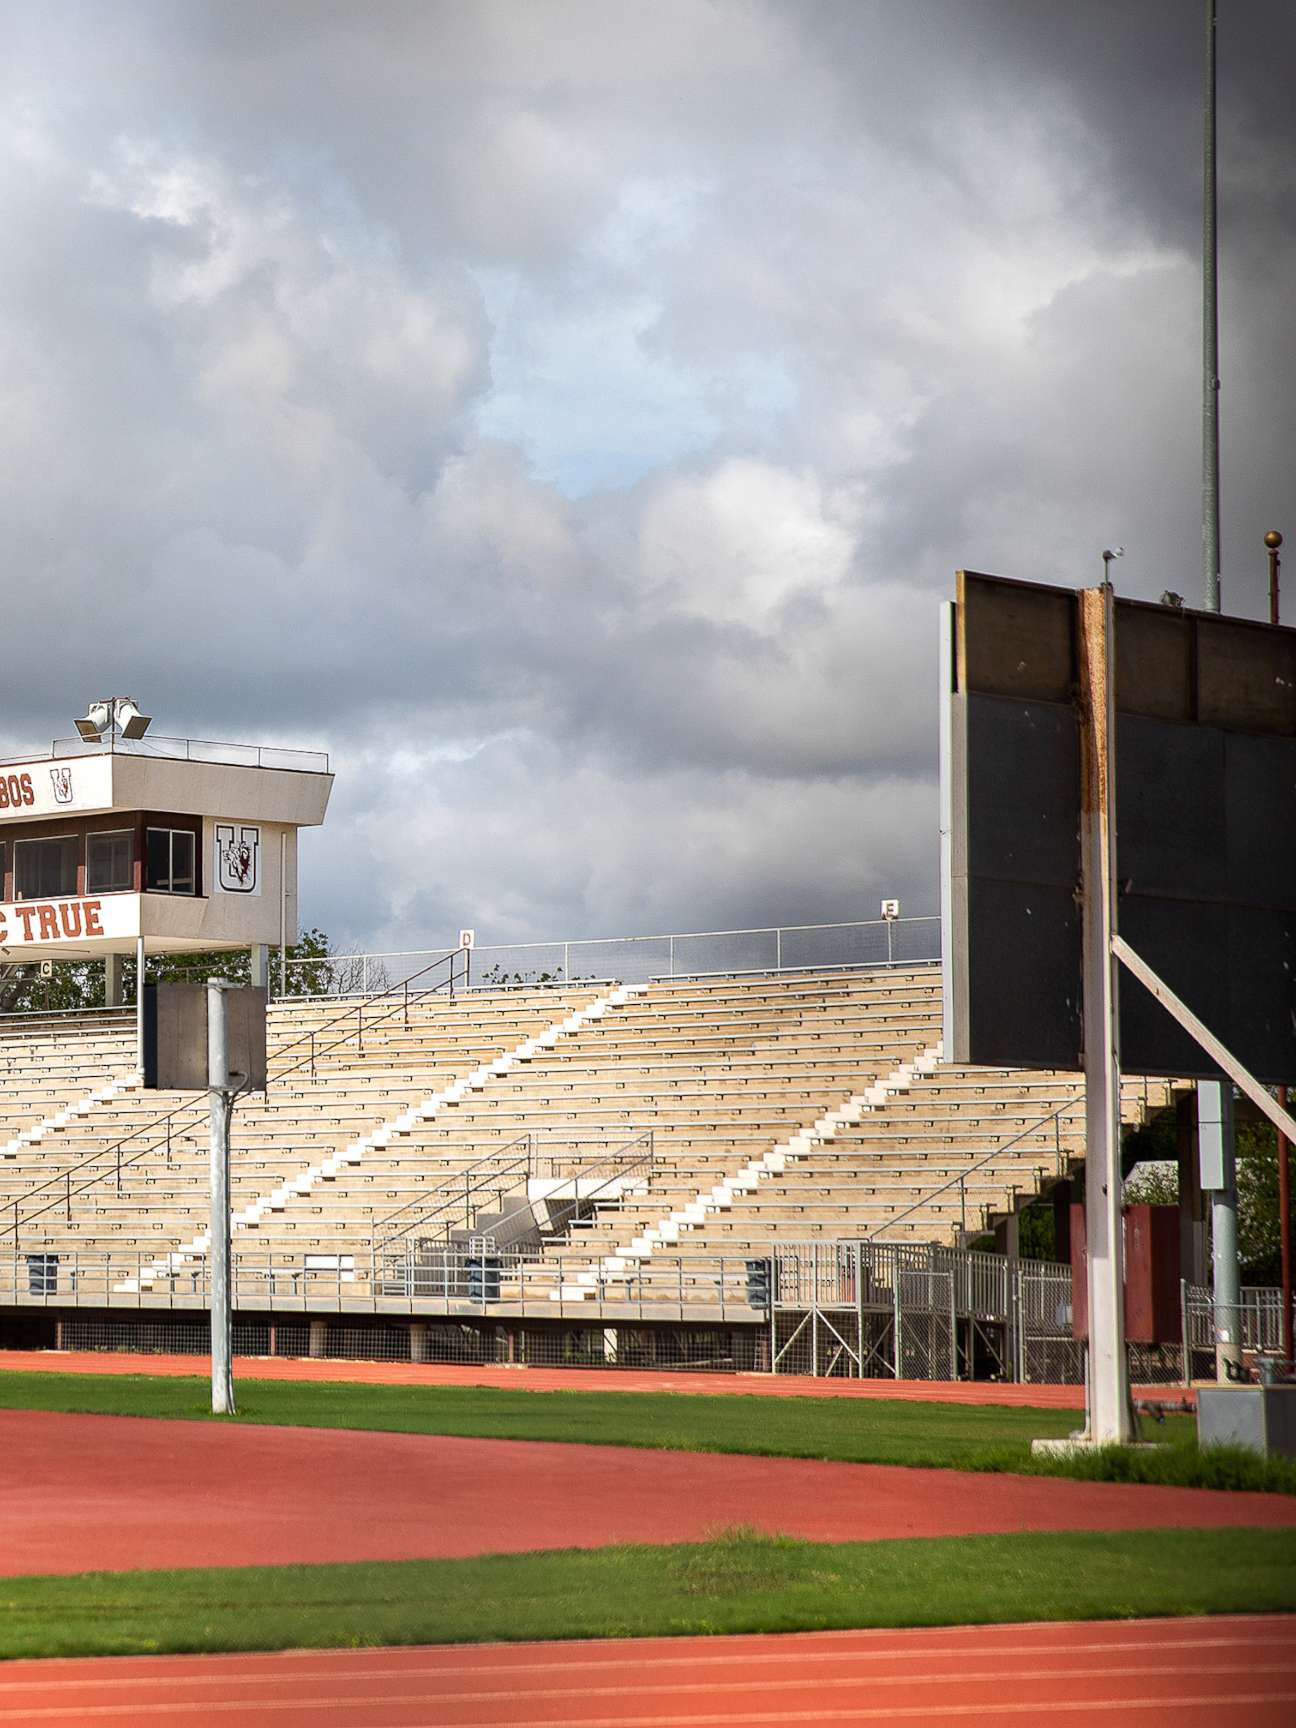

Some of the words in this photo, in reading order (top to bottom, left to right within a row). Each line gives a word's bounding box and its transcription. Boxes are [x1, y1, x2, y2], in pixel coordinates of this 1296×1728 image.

[15, 901, 105, 942] TRUE
[463, 933, 471, 946] D
[42, 962, 50, 975] C
